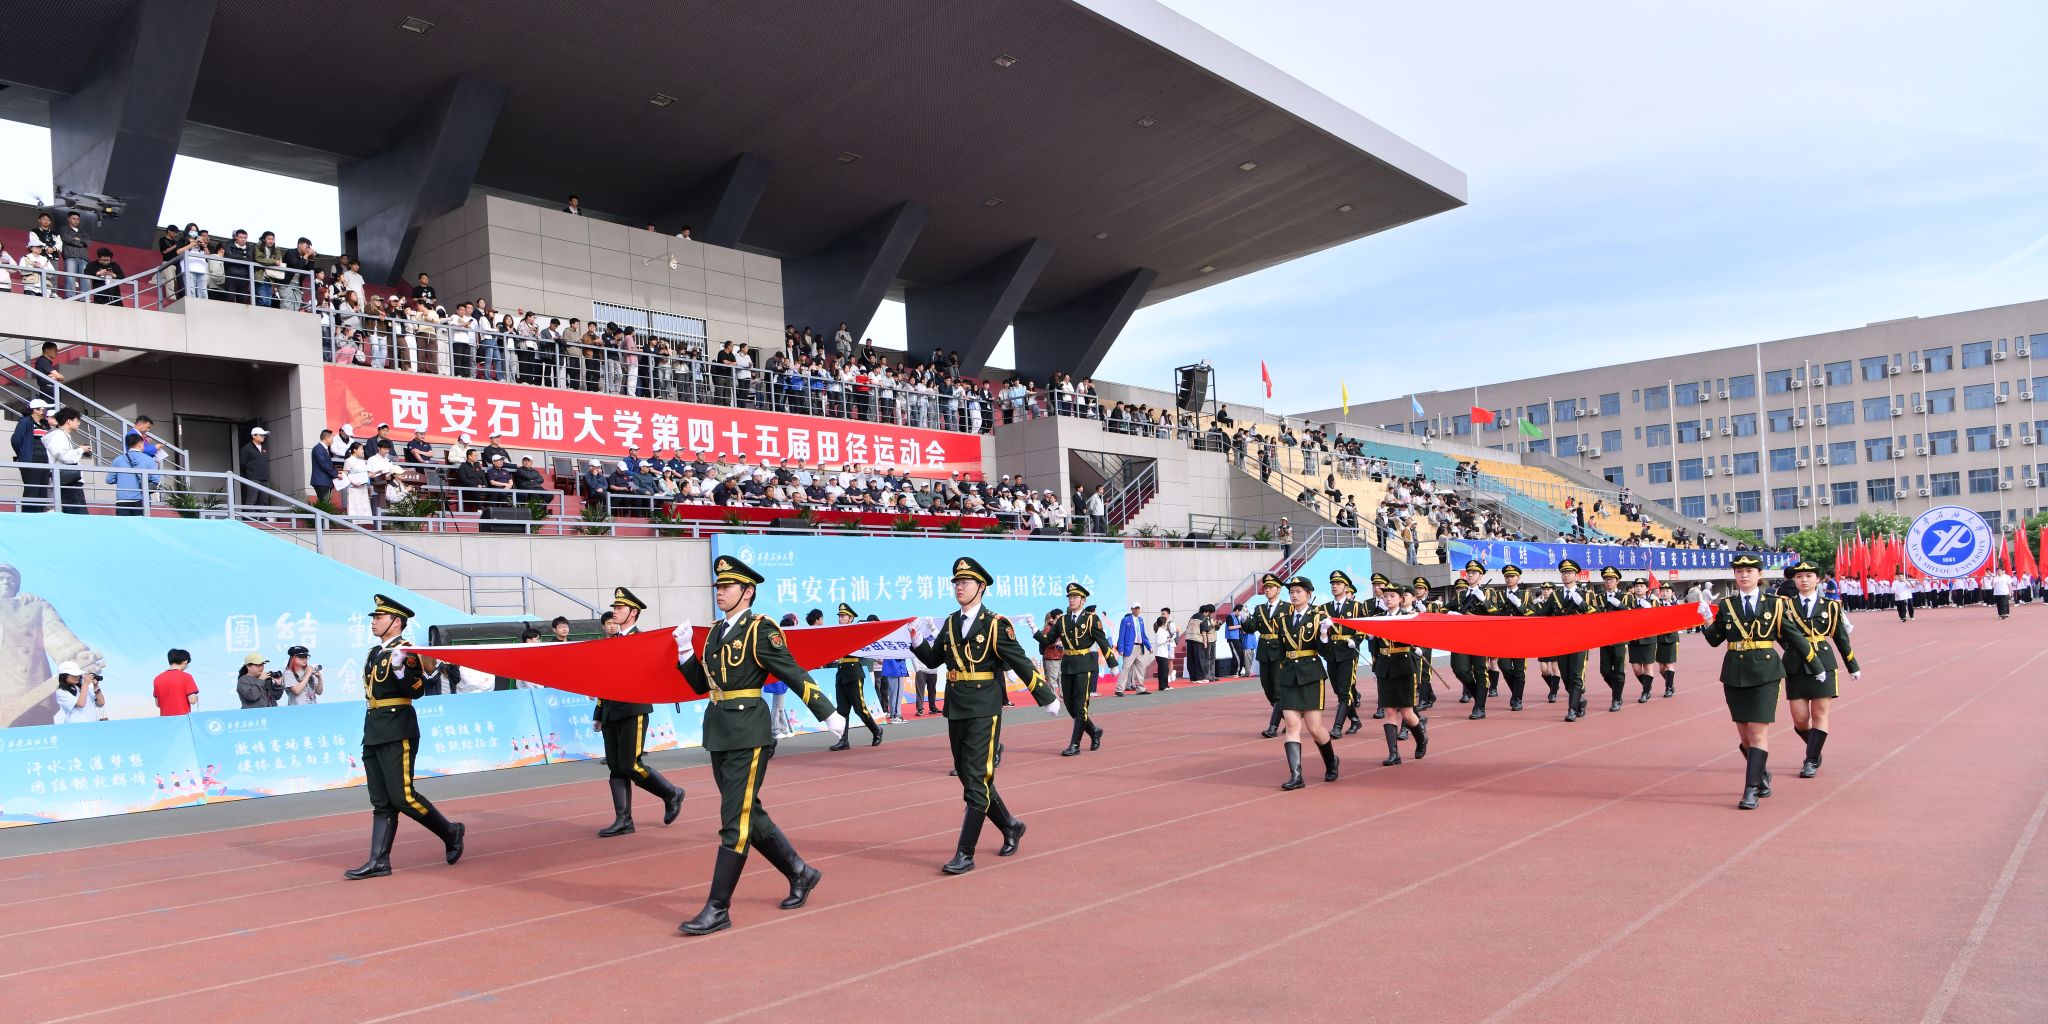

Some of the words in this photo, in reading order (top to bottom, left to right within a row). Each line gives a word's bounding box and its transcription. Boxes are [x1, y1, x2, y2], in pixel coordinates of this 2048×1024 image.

[389, 388, 946, 471] 西安石油大学第四十五届田径运动会
[1955, 540, 1986, 572] UNIVERSITY
